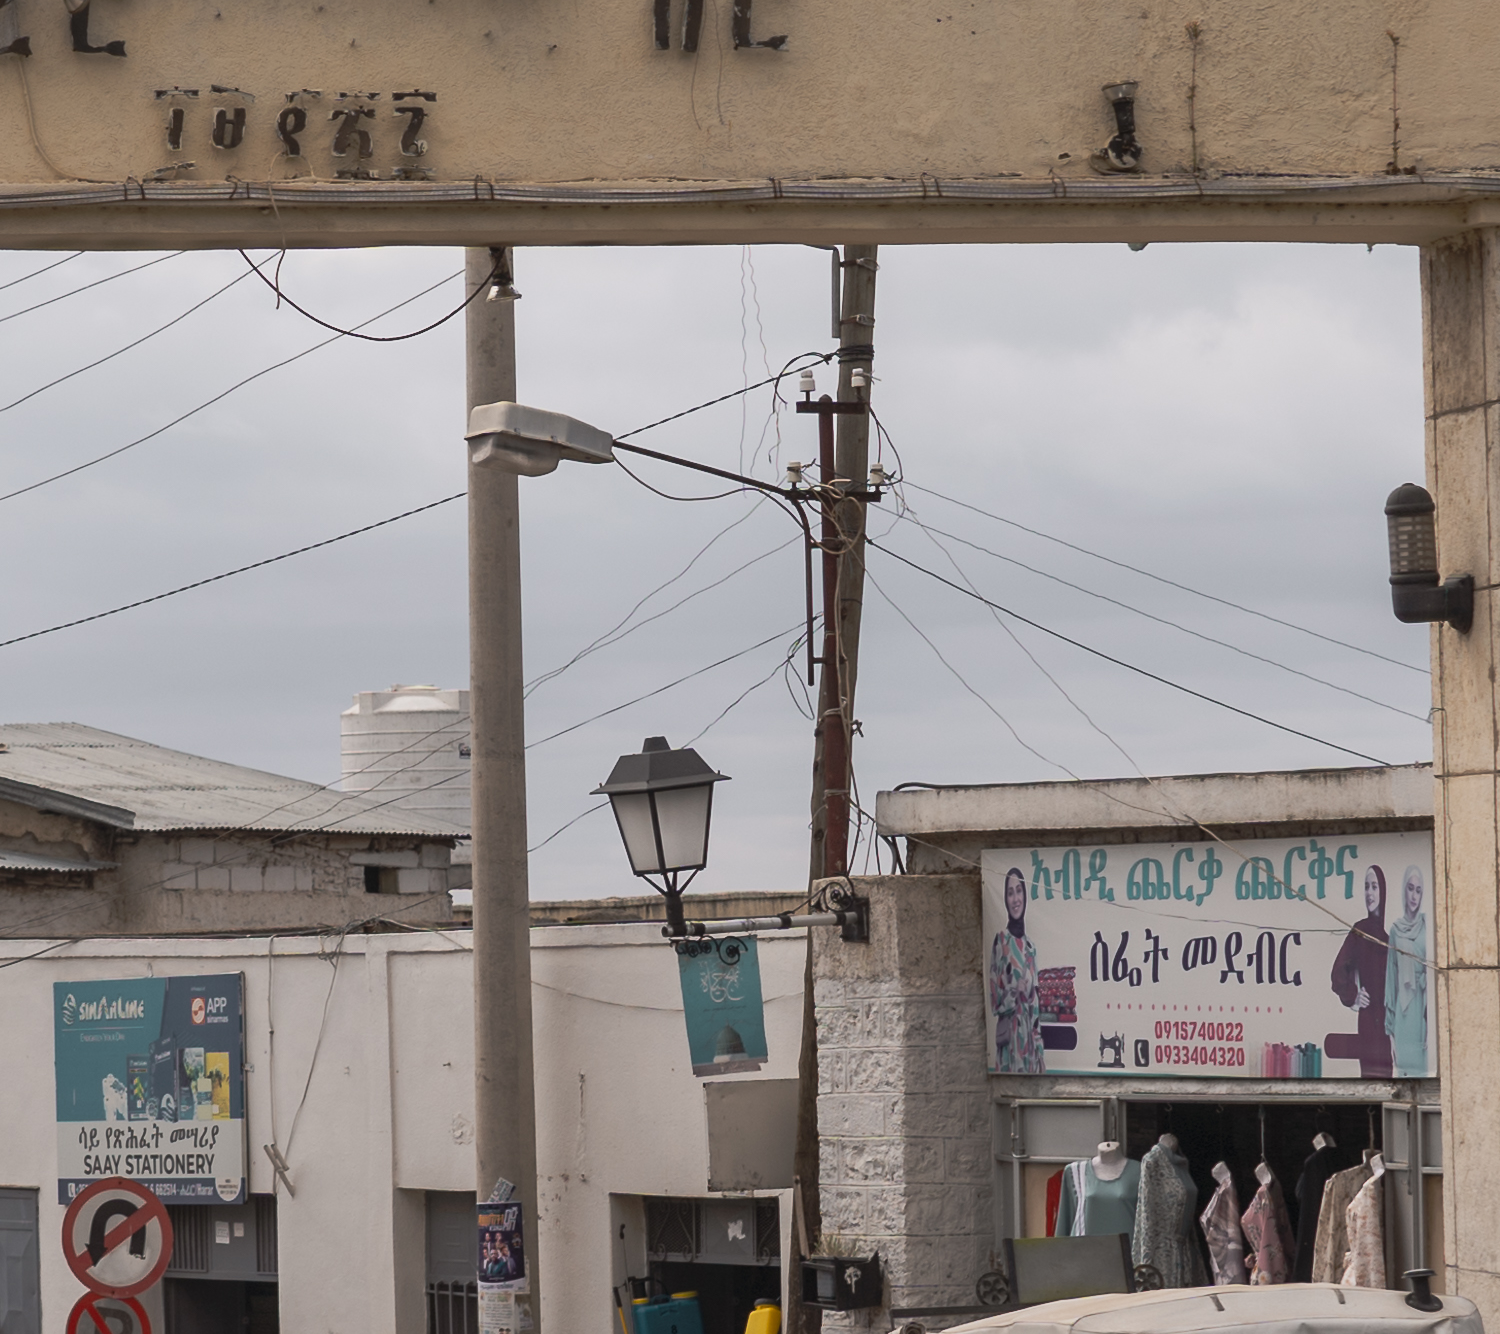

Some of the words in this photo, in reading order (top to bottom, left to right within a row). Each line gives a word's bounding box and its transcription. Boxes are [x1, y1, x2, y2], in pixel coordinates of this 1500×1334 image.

[1030, 848, 1115, 902] አብዲ
[1127, 847, 1222, 907] ጨርቃ
[1235, 839, 1358, 900] ጨርቅና
[1090, 928, 1170, 987] ስፌት
[1182, 931, 1302, 987] መደብር
[207, 997, 227, 1013] APP
[1155, 1021, 1244, 1042] 0915740022
[1155, 1045, 1245, 1067] 0933404320
[84, 1155, 121, 1174] SAAY
[125, 1154, 215, 1174] STATIONERY
